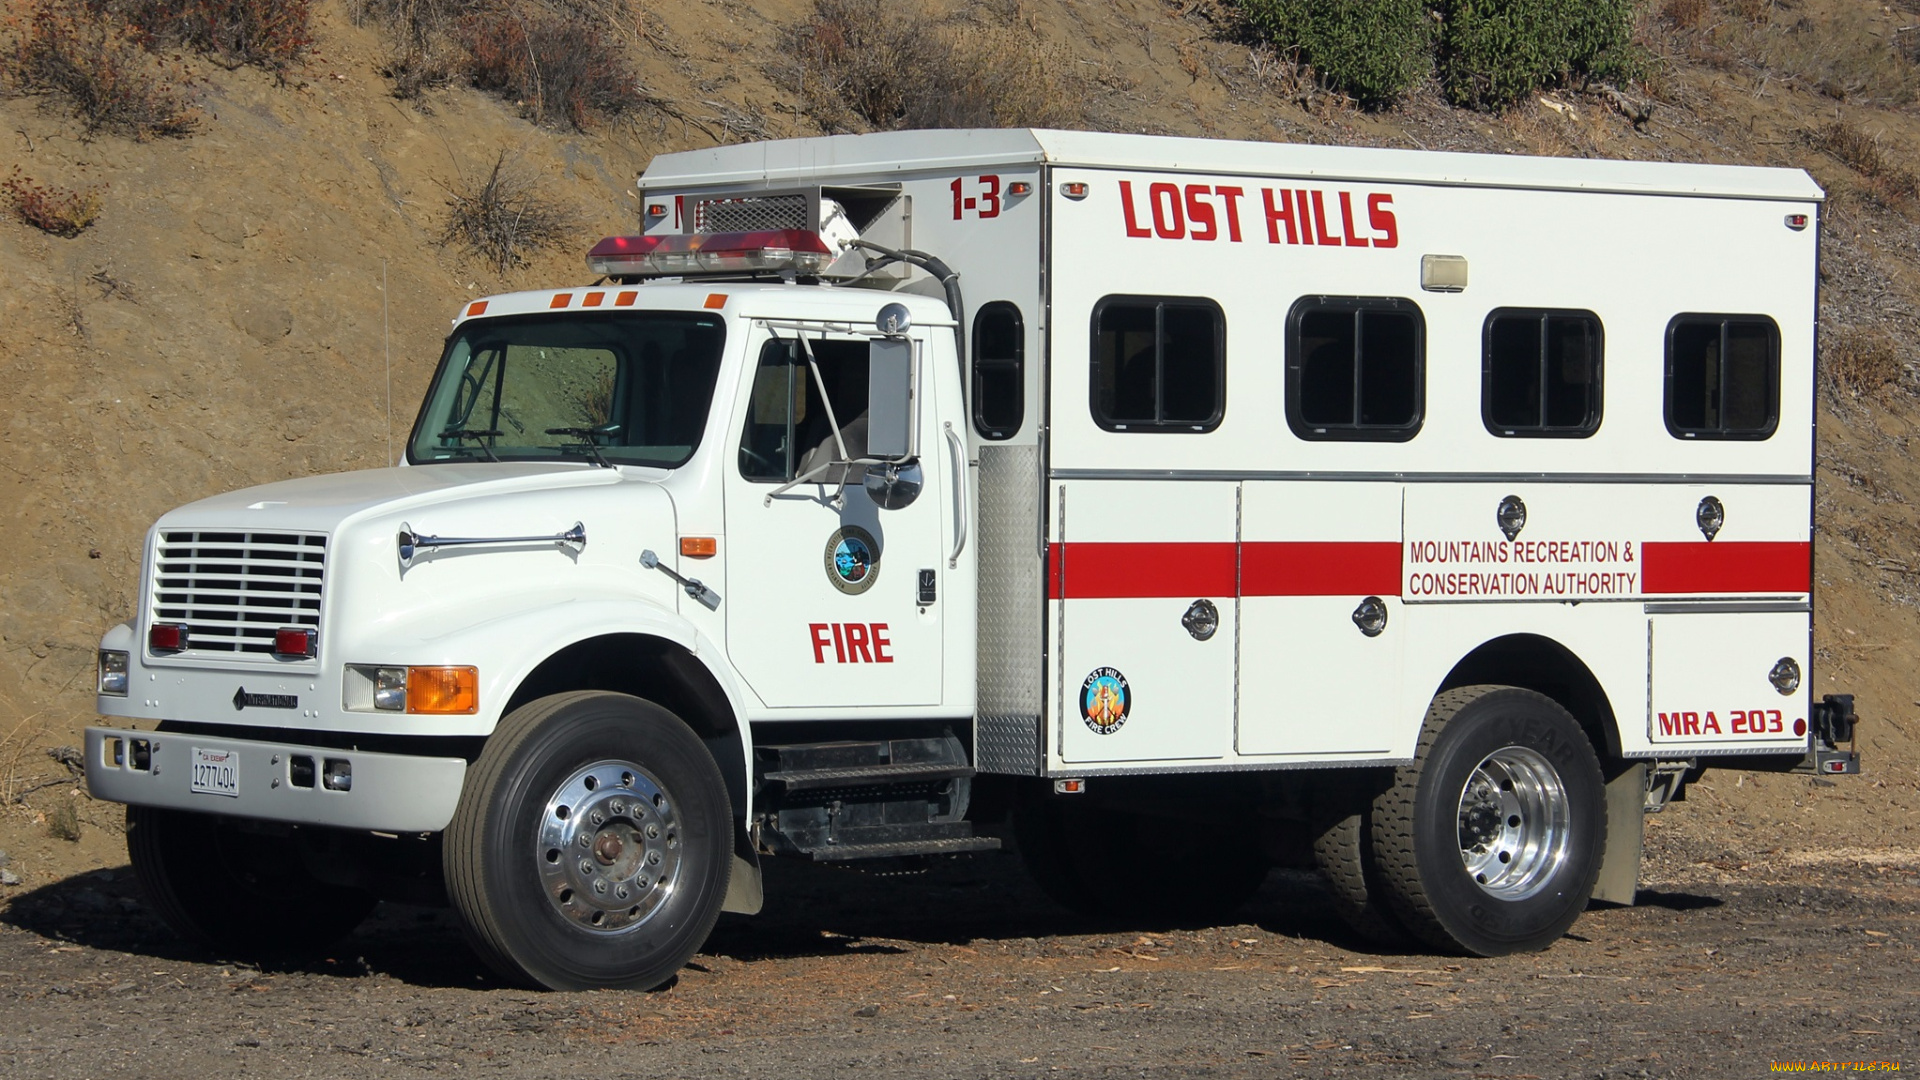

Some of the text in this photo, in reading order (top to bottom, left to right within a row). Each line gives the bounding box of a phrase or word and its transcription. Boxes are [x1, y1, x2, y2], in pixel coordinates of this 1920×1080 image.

[950, 175, 1000, 221] 1-3
[1118, 180, 1399, 249] LOST HILLS
[1410, 540, 1634, 563] MOUNTAINS RECREATION &
[1409, 572, 1637, 595] CONSERVATION AUTHORITY
[808, 623, 894, 663] FIRE
[1083, 668, 1127, 689] LOST HILLS
[1085, 713, 1127, 734] FIRE CREW
[1657, 710, 1783, 736] MRA 203
[193, 764, 235, 789] 1277404
